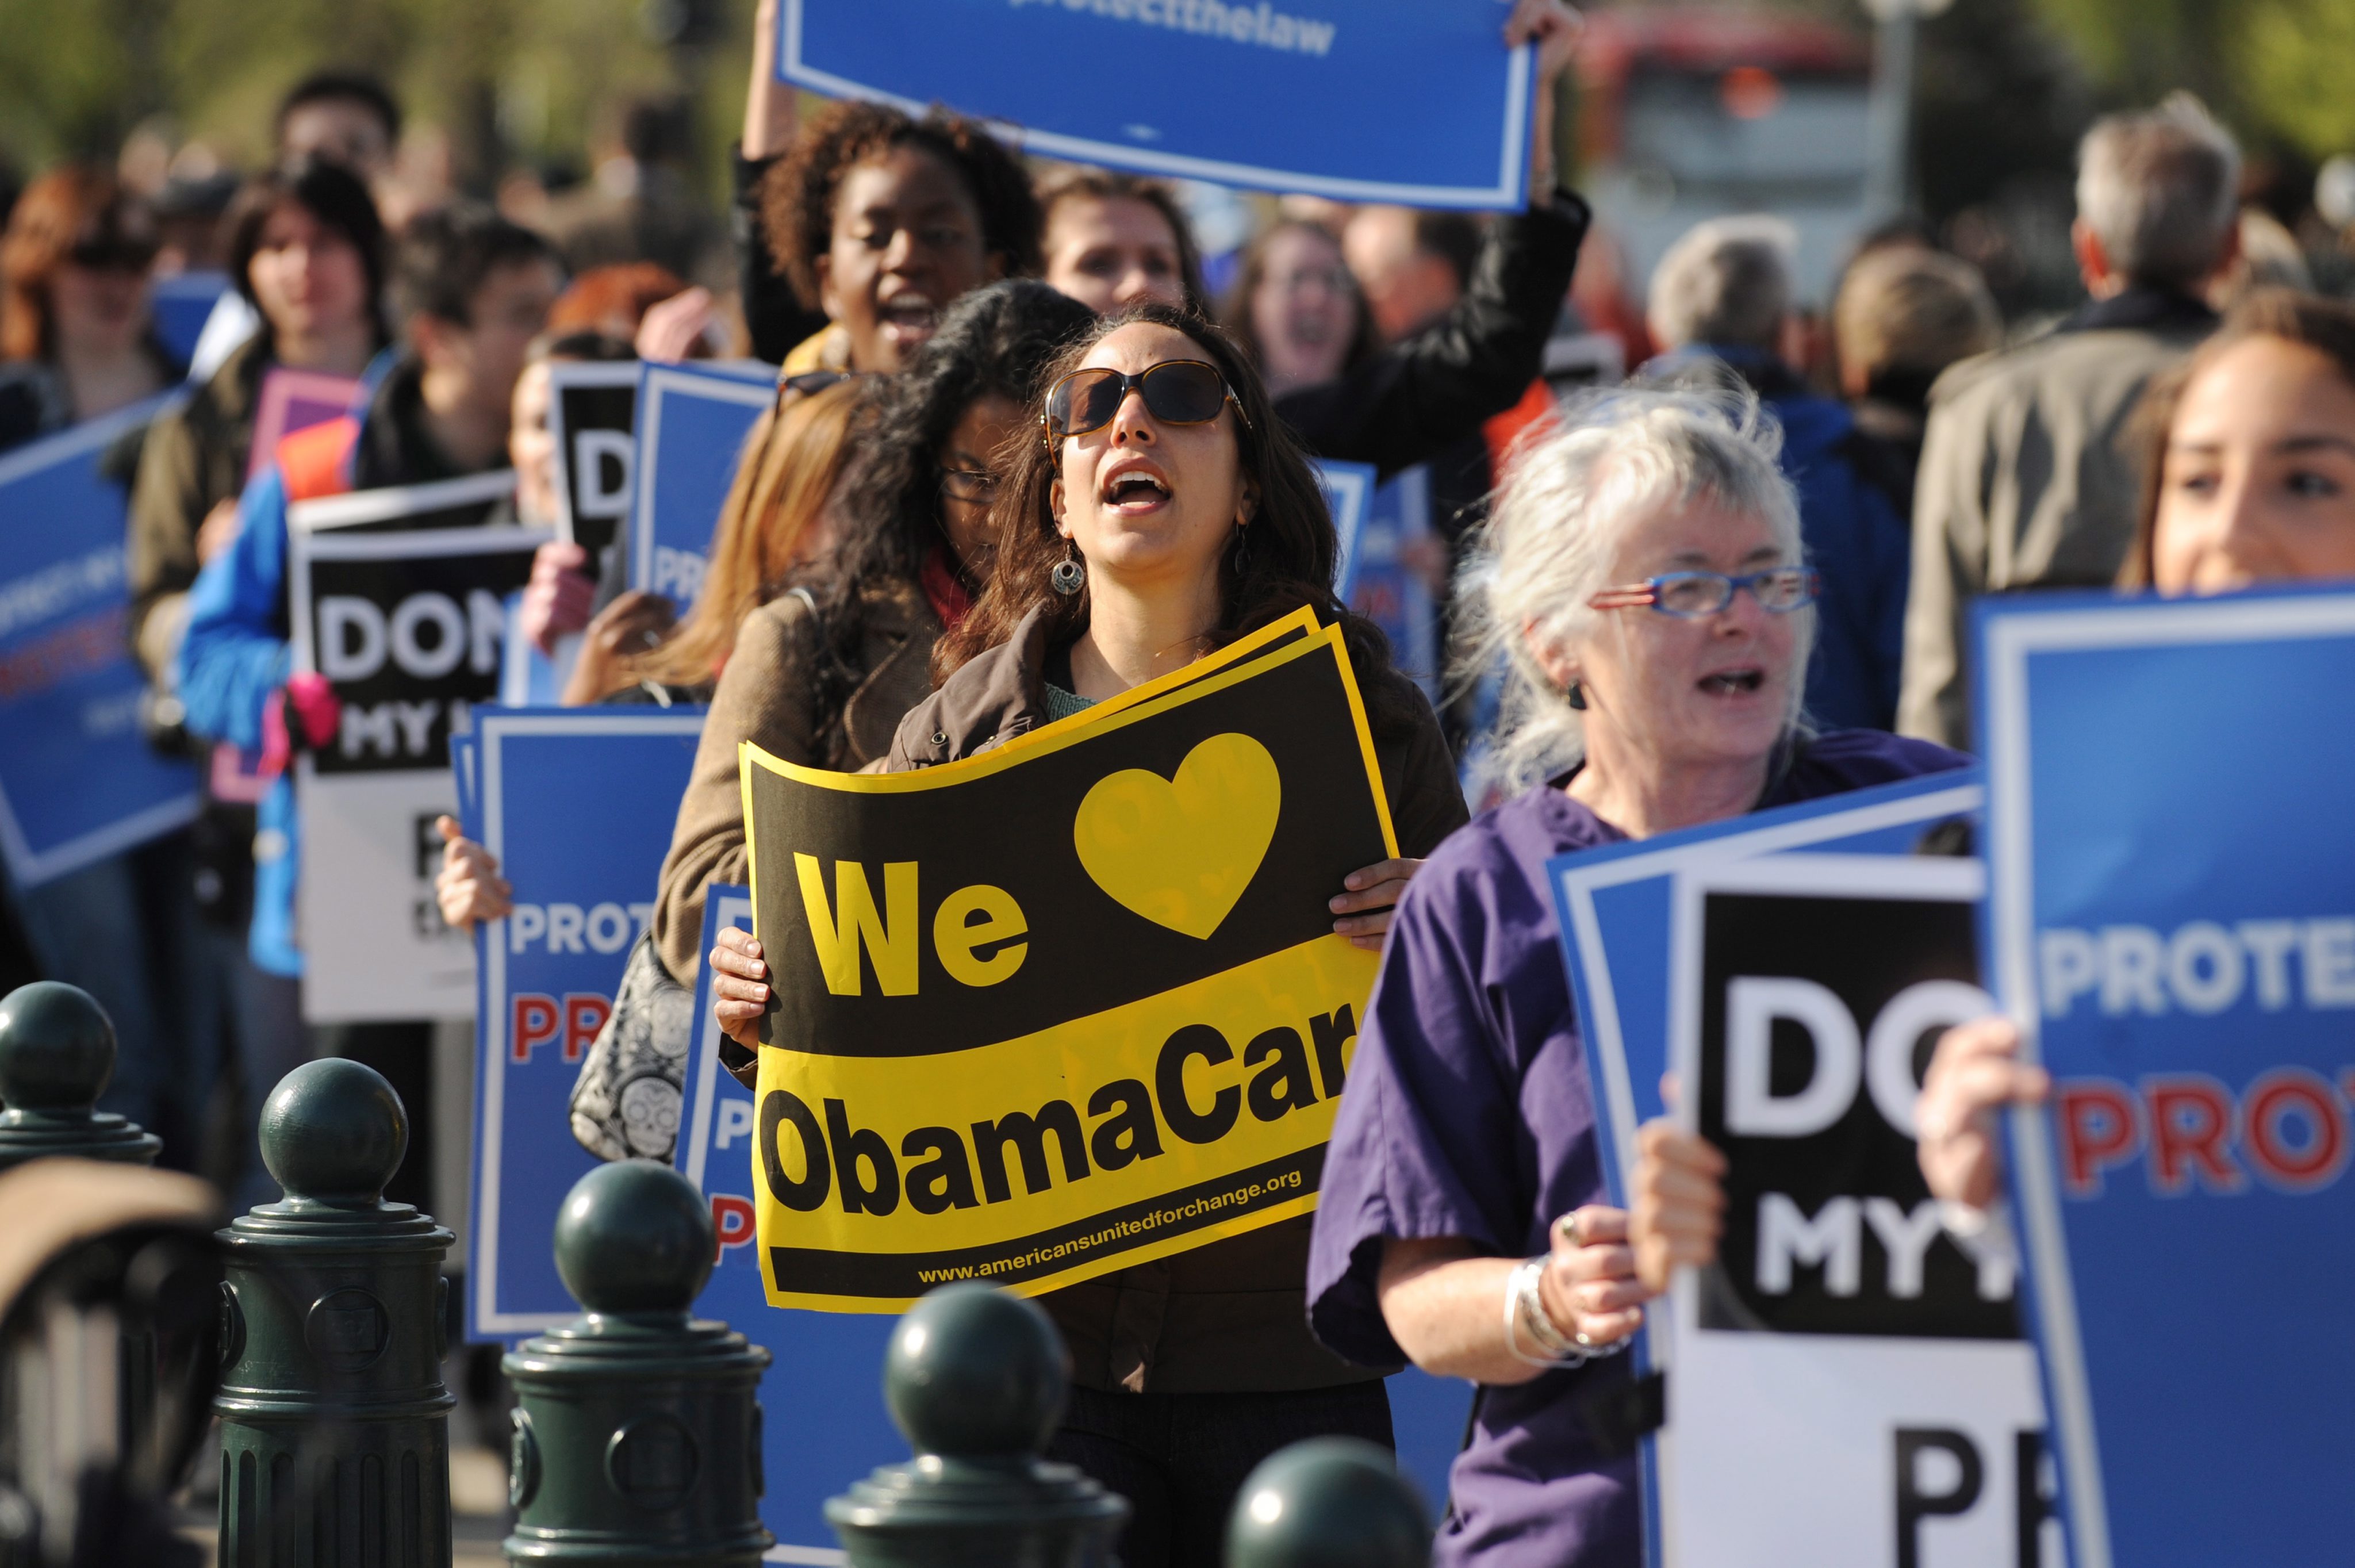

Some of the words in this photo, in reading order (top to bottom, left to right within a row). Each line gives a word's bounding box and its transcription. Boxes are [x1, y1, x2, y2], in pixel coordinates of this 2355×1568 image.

[1007, 0, 1336, 56] ectthelaw
[793, 852, 1029, 997] We
[759, 1002, 1357, 1217] ObamaCar
[2057, 1065, 2355, 1199] PRO
[918, 1170, 1302, 1283] www.americansunitedforchange.org
